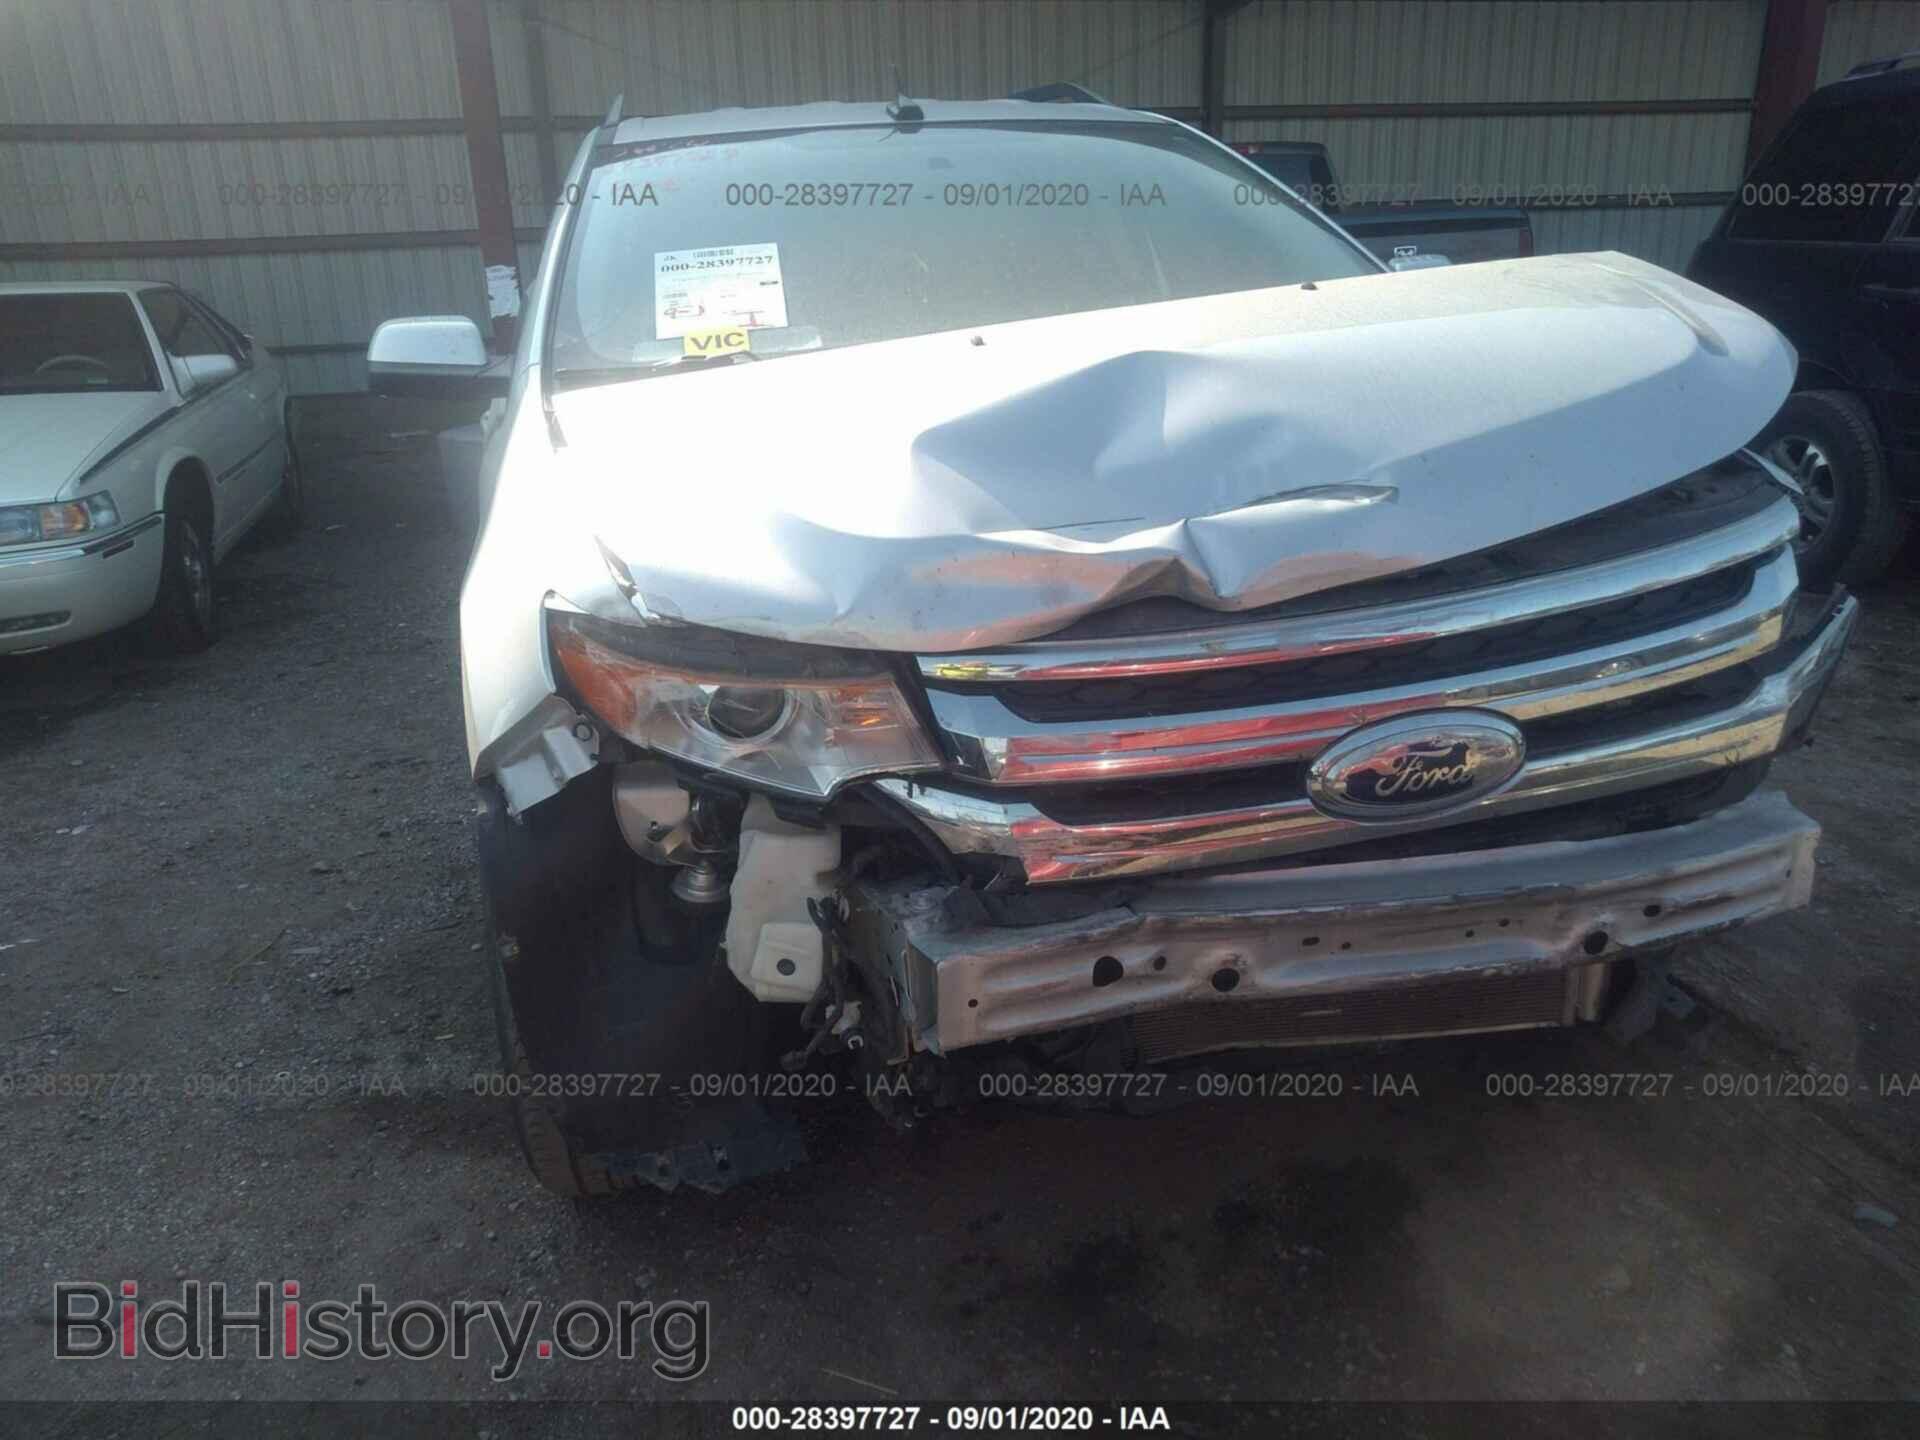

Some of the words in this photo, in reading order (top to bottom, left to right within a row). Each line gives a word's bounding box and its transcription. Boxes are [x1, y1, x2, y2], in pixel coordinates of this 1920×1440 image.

[660, 255, 774, 273] 000-28397727
[690, 332, 745, 350] VIC
[1375, 756, 1472, 798] Ford
